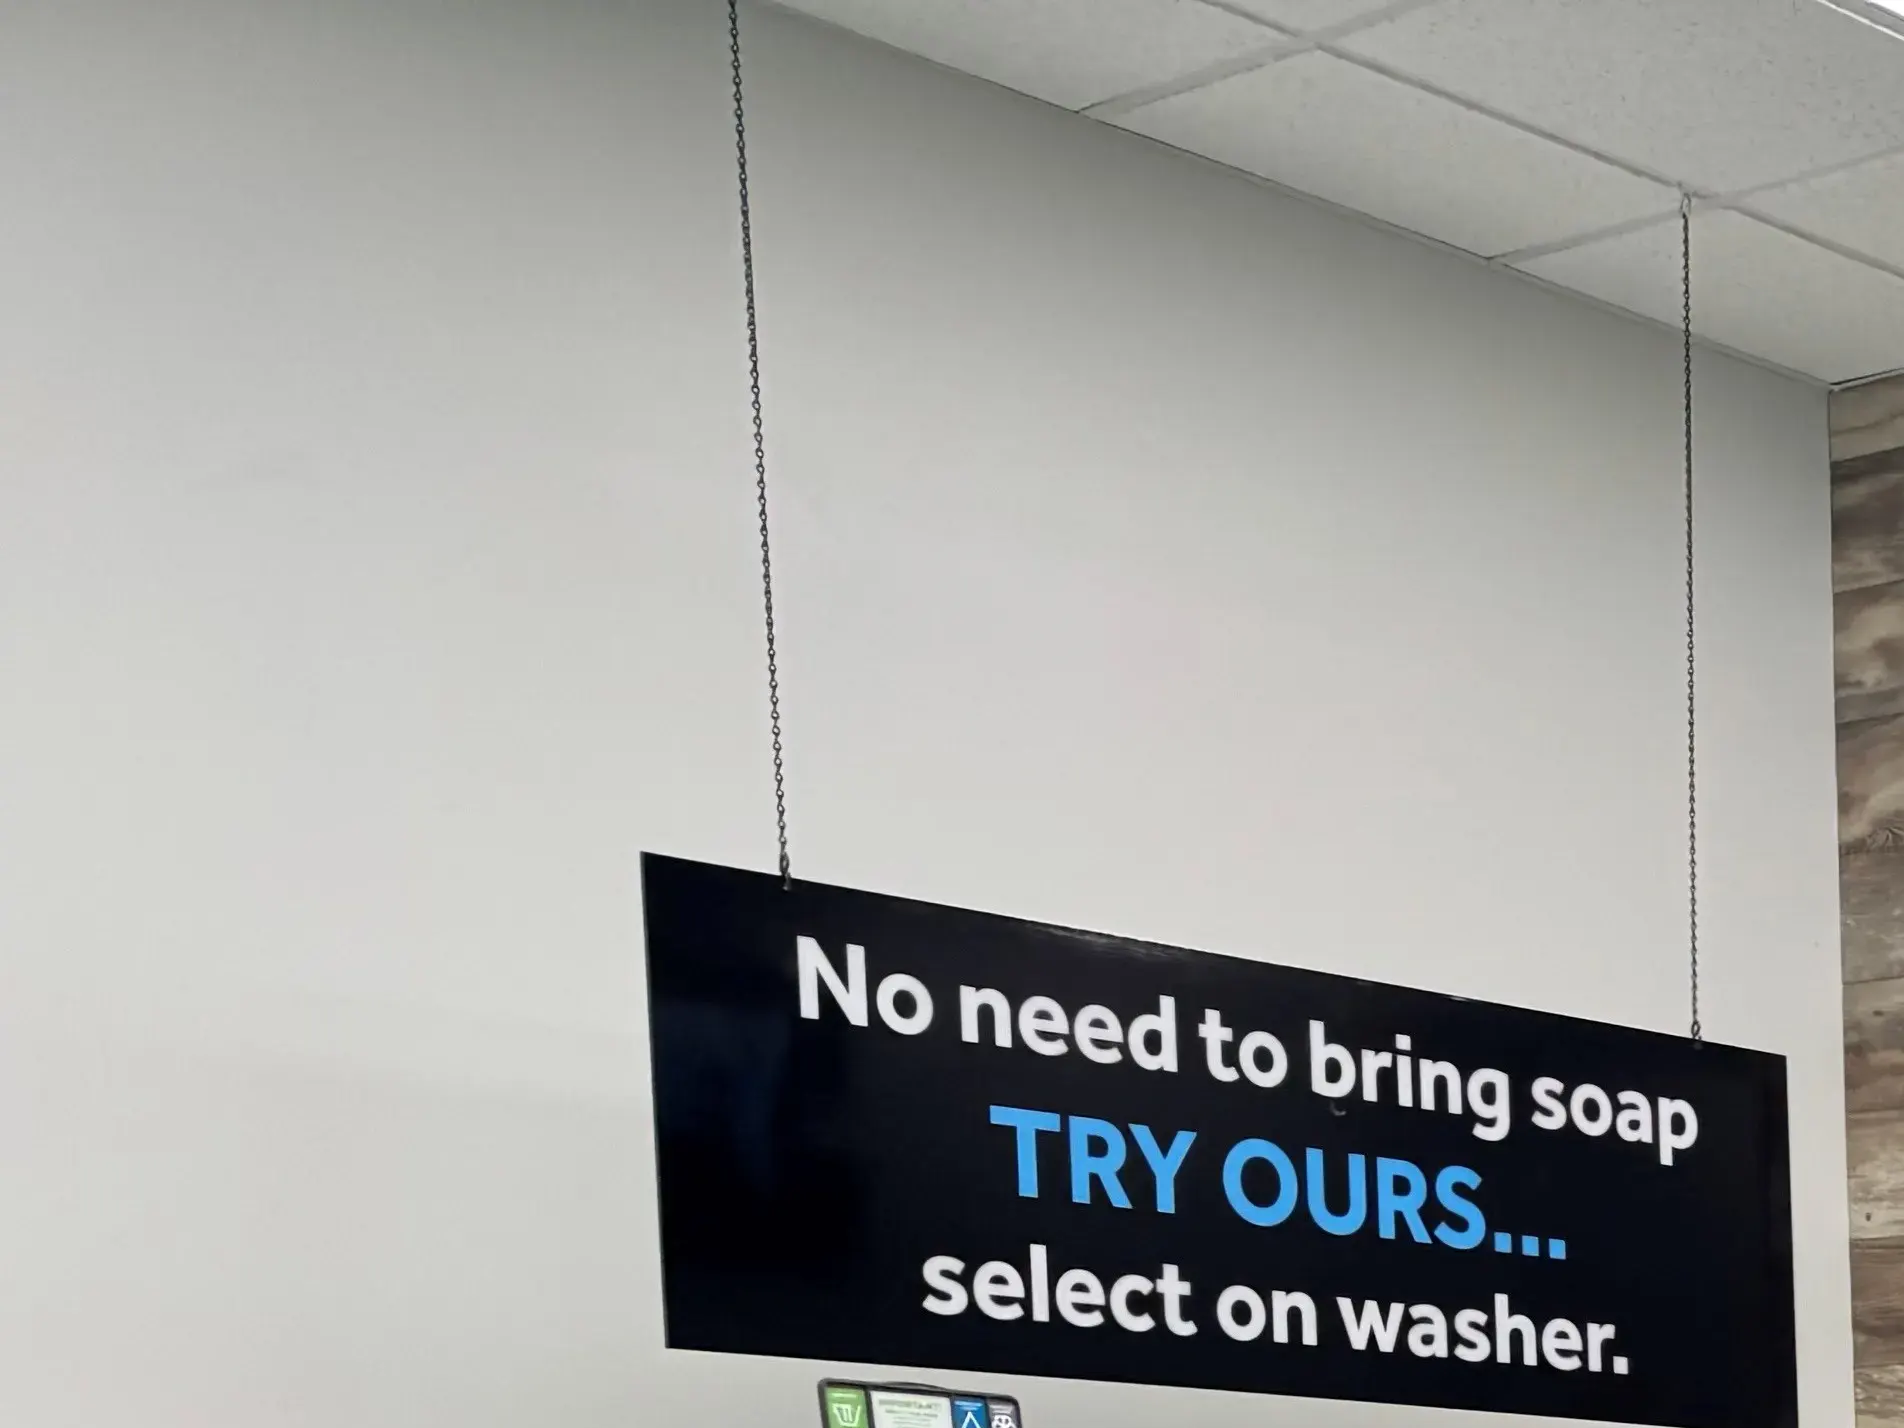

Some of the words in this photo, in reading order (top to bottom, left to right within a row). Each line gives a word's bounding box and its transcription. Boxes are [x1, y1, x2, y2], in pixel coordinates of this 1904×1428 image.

[796, 935, 933, 1037] No
[962, 995, 1177, 1076] need
[1201, 1008, 1289, 1091] to
[1309, 1018, 1509, 1142] bring
[1530, 1076, 1699, 1166] soap
[991, 1105, 1197, 1218] TRY
[1222, 1138, 1567, 1260] OURS...
[920, 1243, 1197, 1338] select
[1216, 1282, 1317, 1348] on
[1336, 1293, 1631, 1376] washer.
